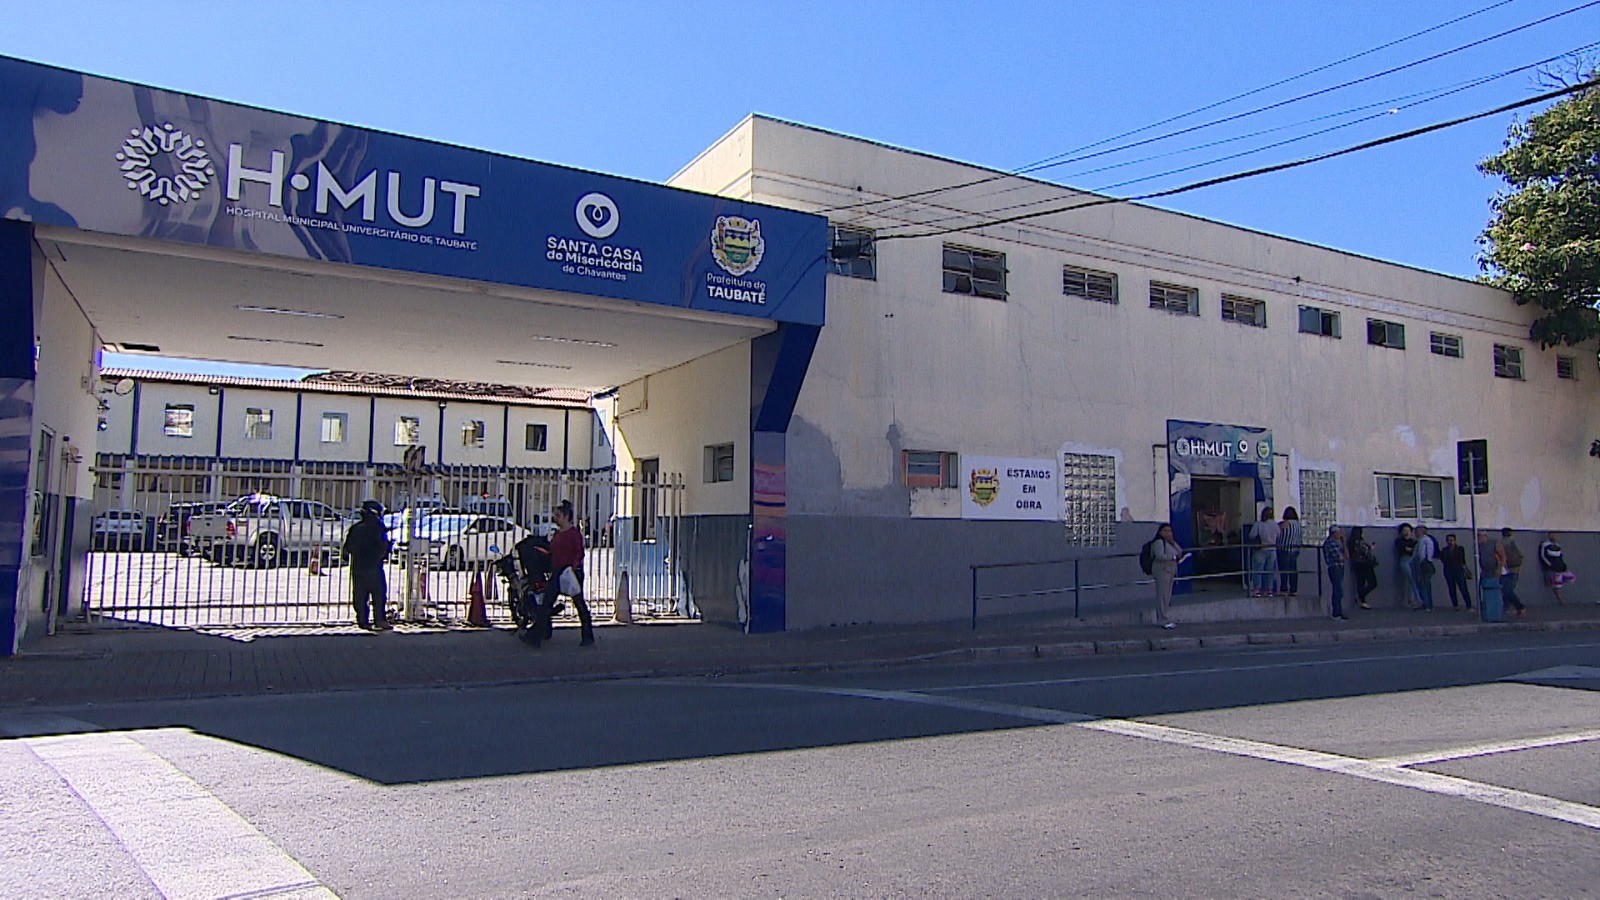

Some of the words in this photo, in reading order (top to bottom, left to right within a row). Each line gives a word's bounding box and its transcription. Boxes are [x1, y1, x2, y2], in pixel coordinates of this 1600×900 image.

[226, 206, 280, 222] HOSPITAL
[283, 215, 340, 231] MUNICIPAL
[342, 224, 418, 242] UNIVERSITÁRIO
[420, 234, 433, 244] DE
[547, 236, 598, 255] SANTA
[601, 245, 643, 262] CASA
[565, 252, 643, 272] Misericórdia
[562, 265, 575, 273] de
[577, 266, 627, 281] Chavantes
[707, 272, 752, 288] Prefeitura
[707, 285, 766, 304] TAUBATÉ
[1007, 468, 1051, 479] ESTAMOS
[1022, 484, 1036, 493] EM
[1016, 500, 1042, 509] OBRA
